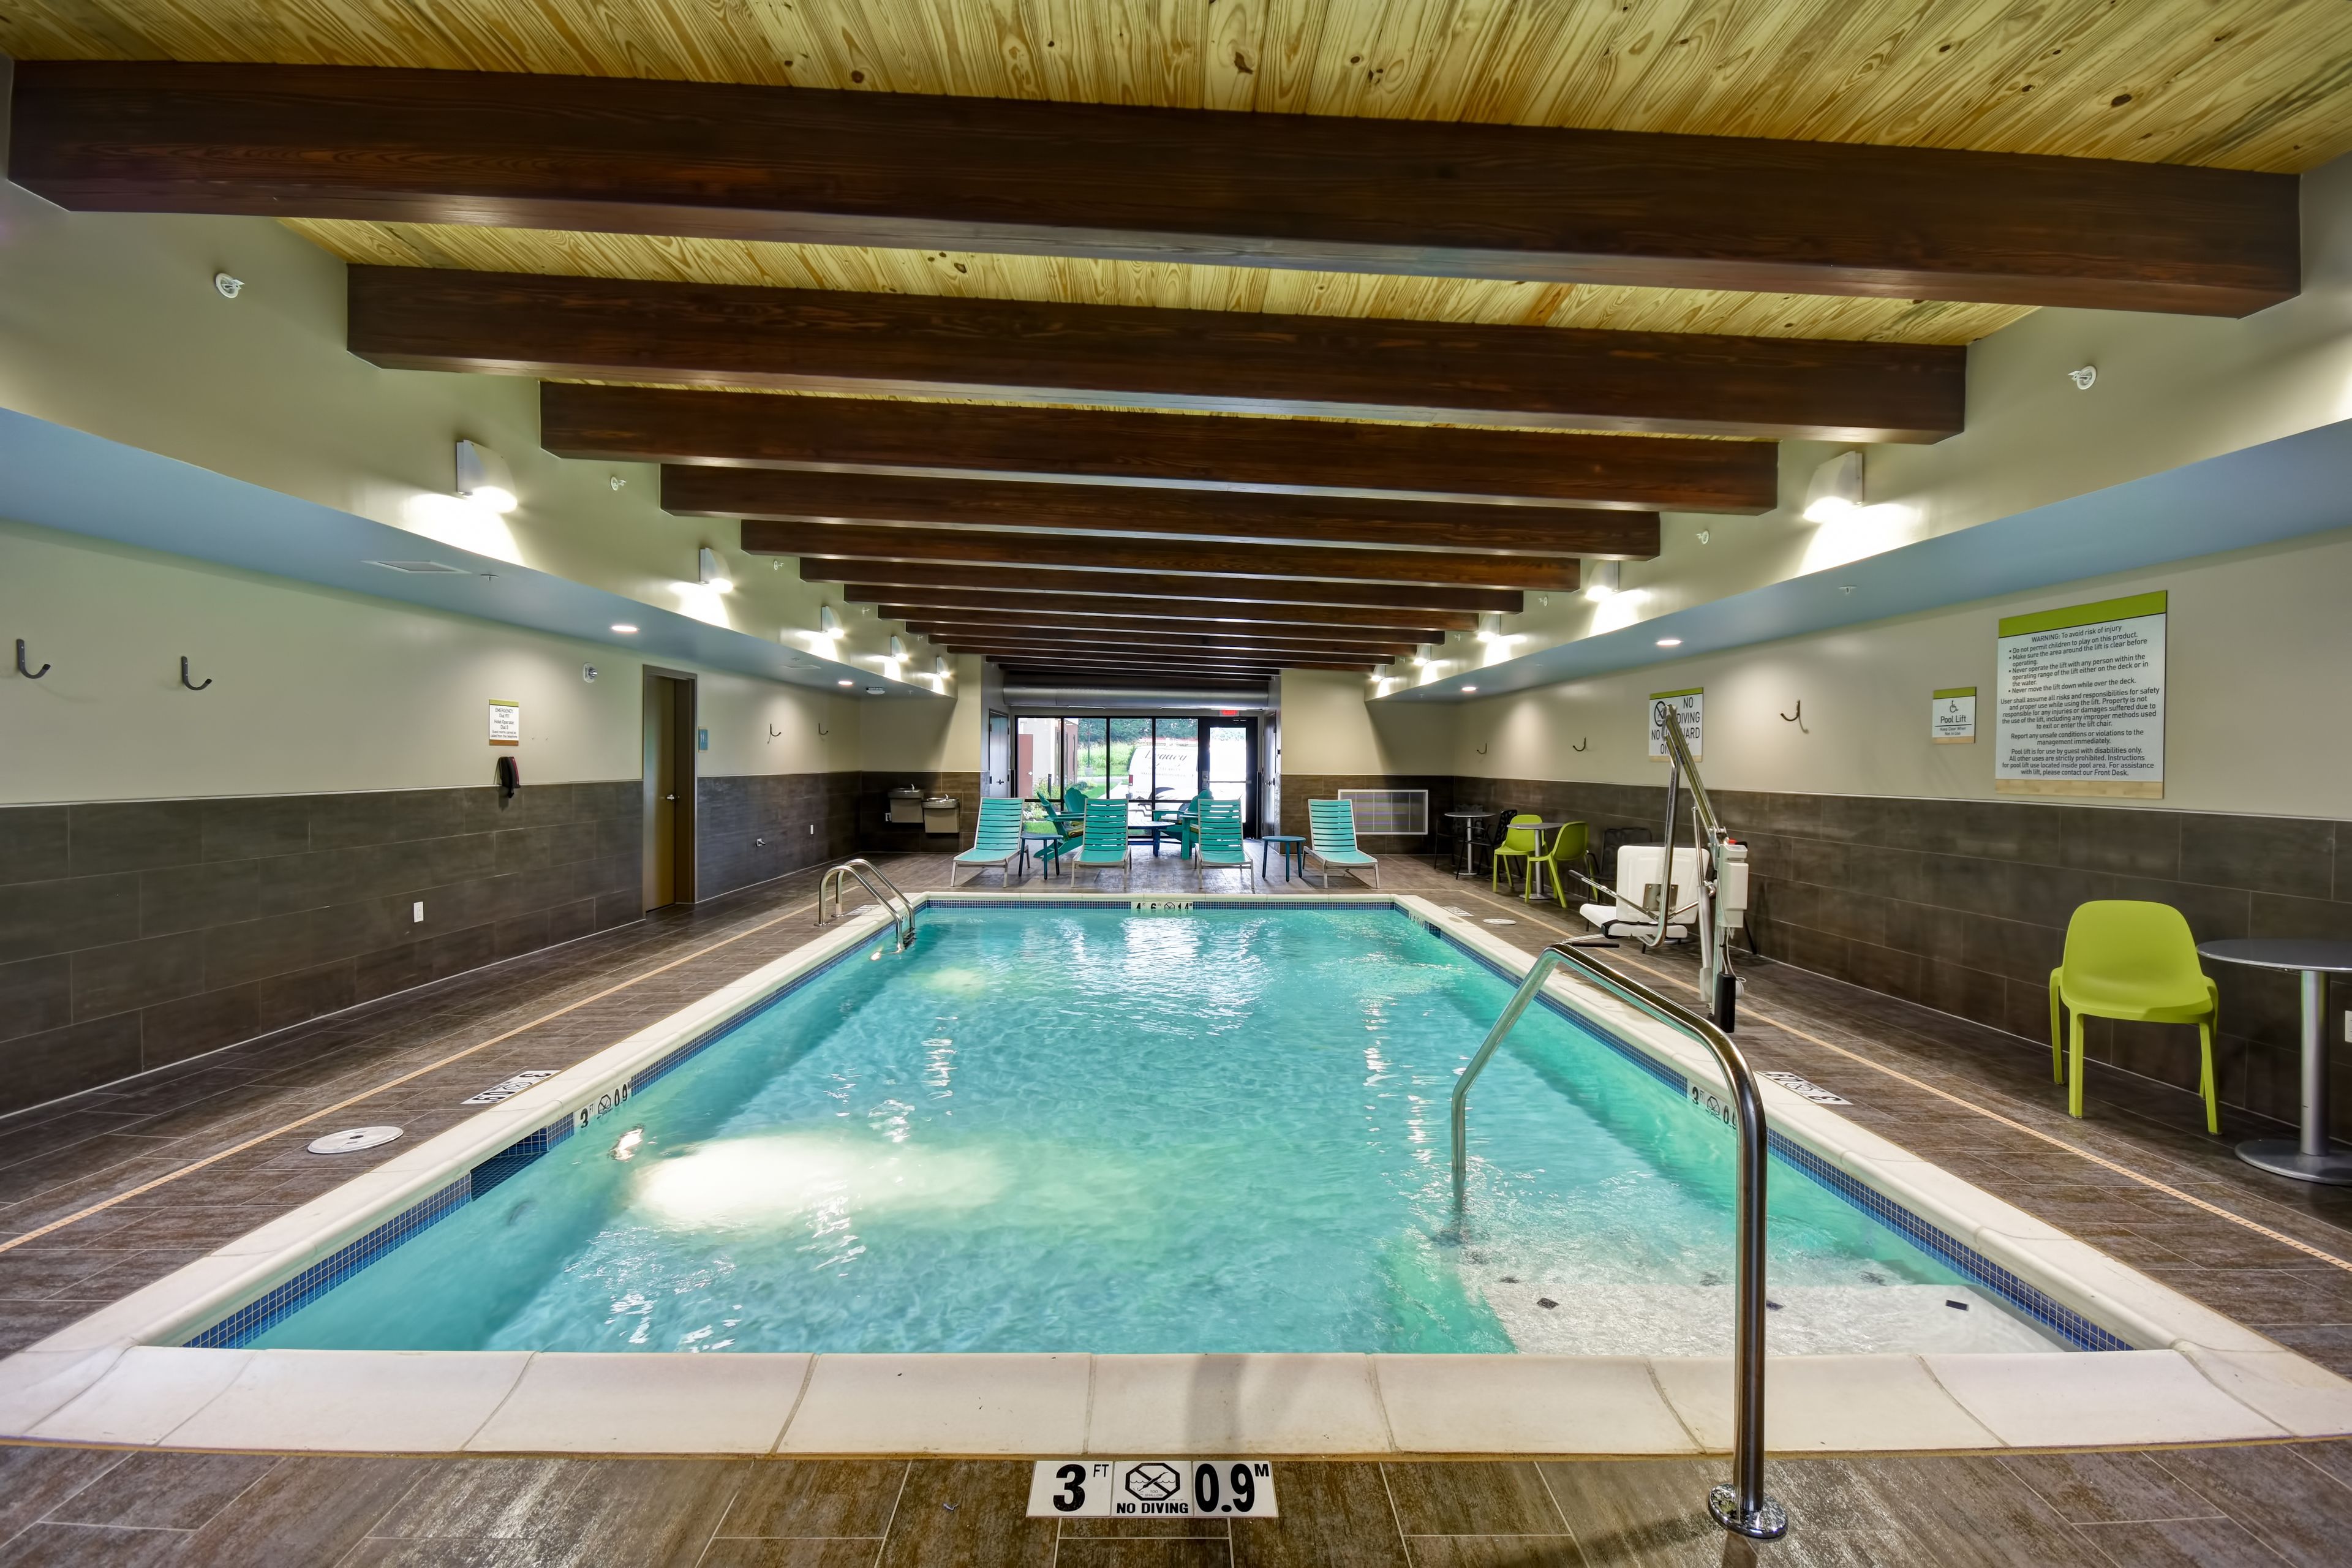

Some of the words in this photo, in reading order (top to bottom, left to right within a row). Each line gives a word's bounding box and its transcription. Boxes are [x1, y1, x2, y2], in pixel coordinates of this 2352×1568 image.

[2079, 638, 2090, 646] play
[2113, 632, 2138, 641] product.
[1683, 697, 1693, 708] NO
[1677, 712, 1700, 724] DIVING
[1651, 729, 1660, 740] NO
[1692, 1087, 1698, 1105] 3
[581, 1108, 589, 1128] 3
[589, 1104, 594, 1114] FT
[628, 1080, 631, 1090] M
[1053, 1464, 1086, 1512] 3
[1093, 1464, 1109, 1477] FT
[1195, 1463, 1255, 1512] 0.9
[1255, 1464, 1269, 1477] M
[1117, 1503, 1136, 1513] NO
[1141, 1503, 1188, 1513] DIVING
